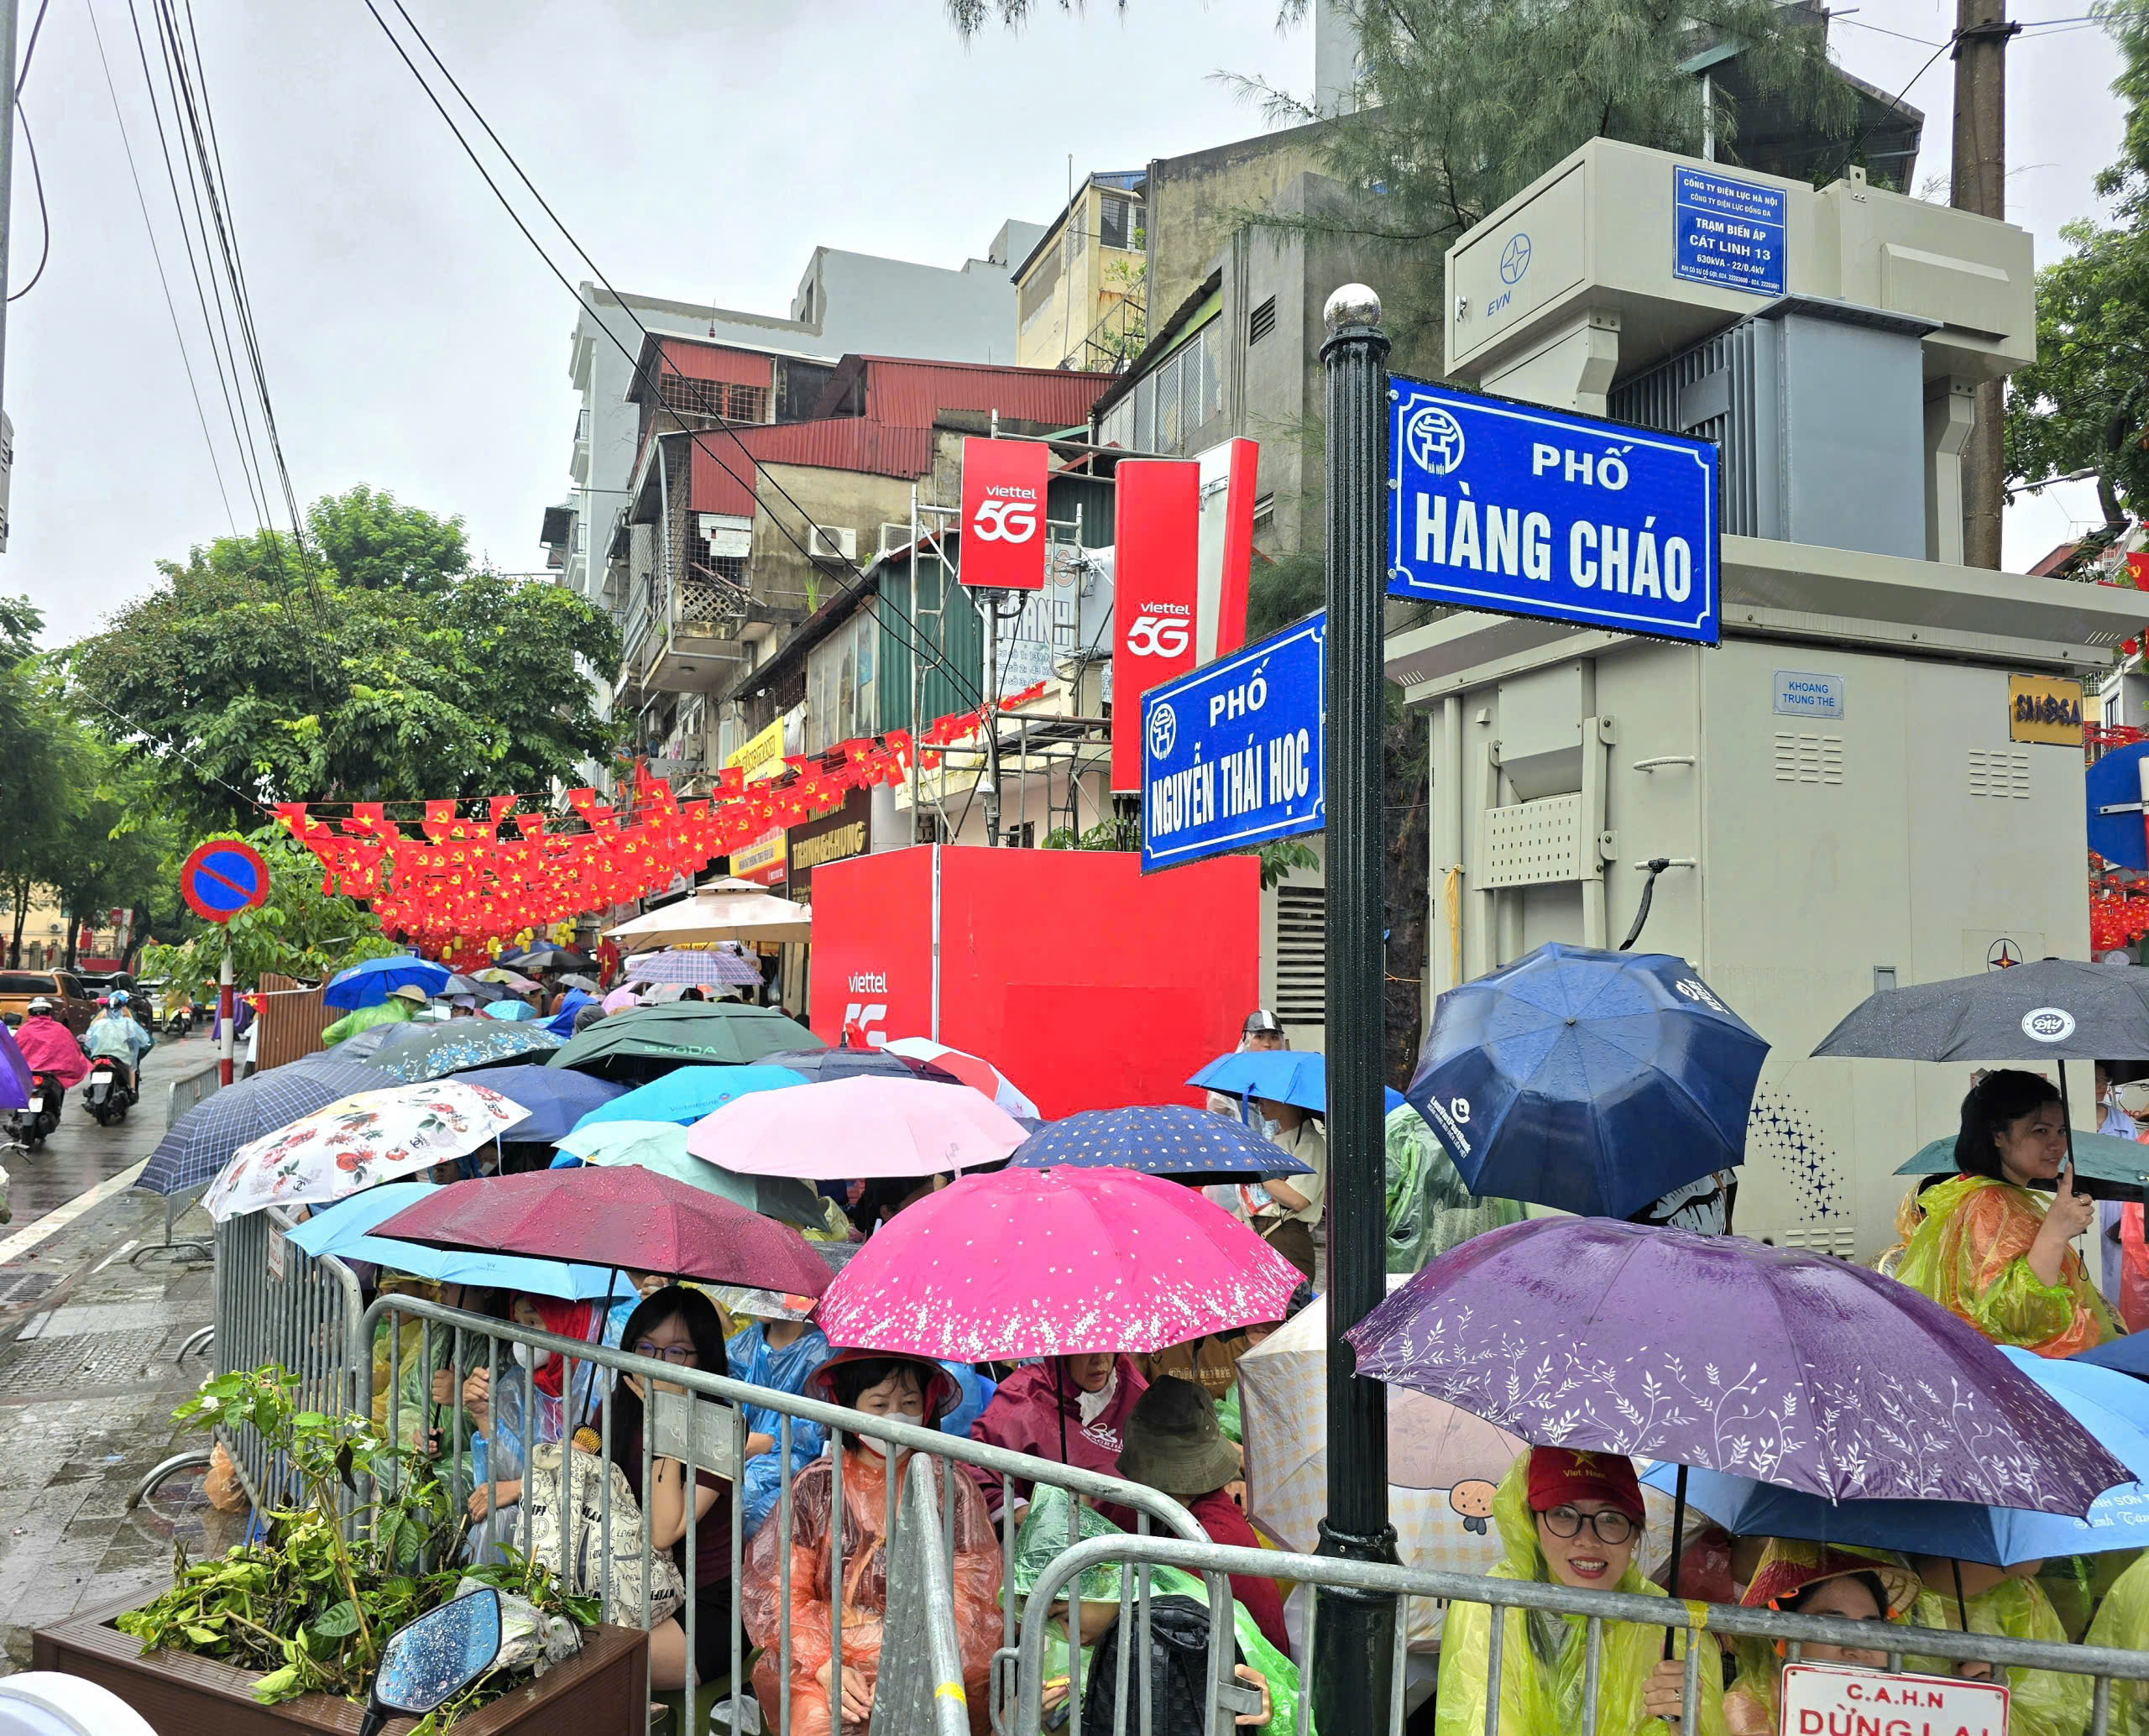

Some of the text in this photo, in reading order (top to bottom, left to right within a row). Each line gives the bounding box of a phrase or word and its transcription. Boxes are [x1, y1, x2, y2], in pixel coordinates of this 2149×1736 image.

[1684, 177, 1778, 207] CÔNG TY ĐIỆN LỰC HÀ NỘI
[1691, 192, 1707, 203] CÔNG
[1717, 198, 1731, 209] ĐIỆN
[1732, 202, 1744, 212] LỰC
[1696, 217, 1766, 241] TRẠM BIẾN ÁP
[1690, 234, 1770, 260] CÁT LINH 13
[1697, 254, 1725, 267] 630kVA
[1732, 261, 1765, 275] 22/0.4kV
[1488, 290, 1511, 316] EVN
[1532, 443, 1633, 490] PHỐ
[986, 484, 1037, 499] viettel
[973, 500, 1037, 543] 5G
[1416, 480, 1691, 603] HÀNG CHÁO
[1141, 602, 1190, 615] viettel
[1127, 616, 1190, 658] 5G
[1210, 657, 1270, 728] PHỐ
[1782, 693, 1814, 705] TRUNG
[1789, 682, 1828, 693] KHOANG
[1152, 729, 1310, 838] NGUYỄN THÁI HỌC
[848, 971, 888, 993] viettel
[2034, 1018, 2063, 1030] DIY
[1563, 1469, 1582, 1477] Viet
[1847, 1683, 1943, 1709] C.A.H.N
